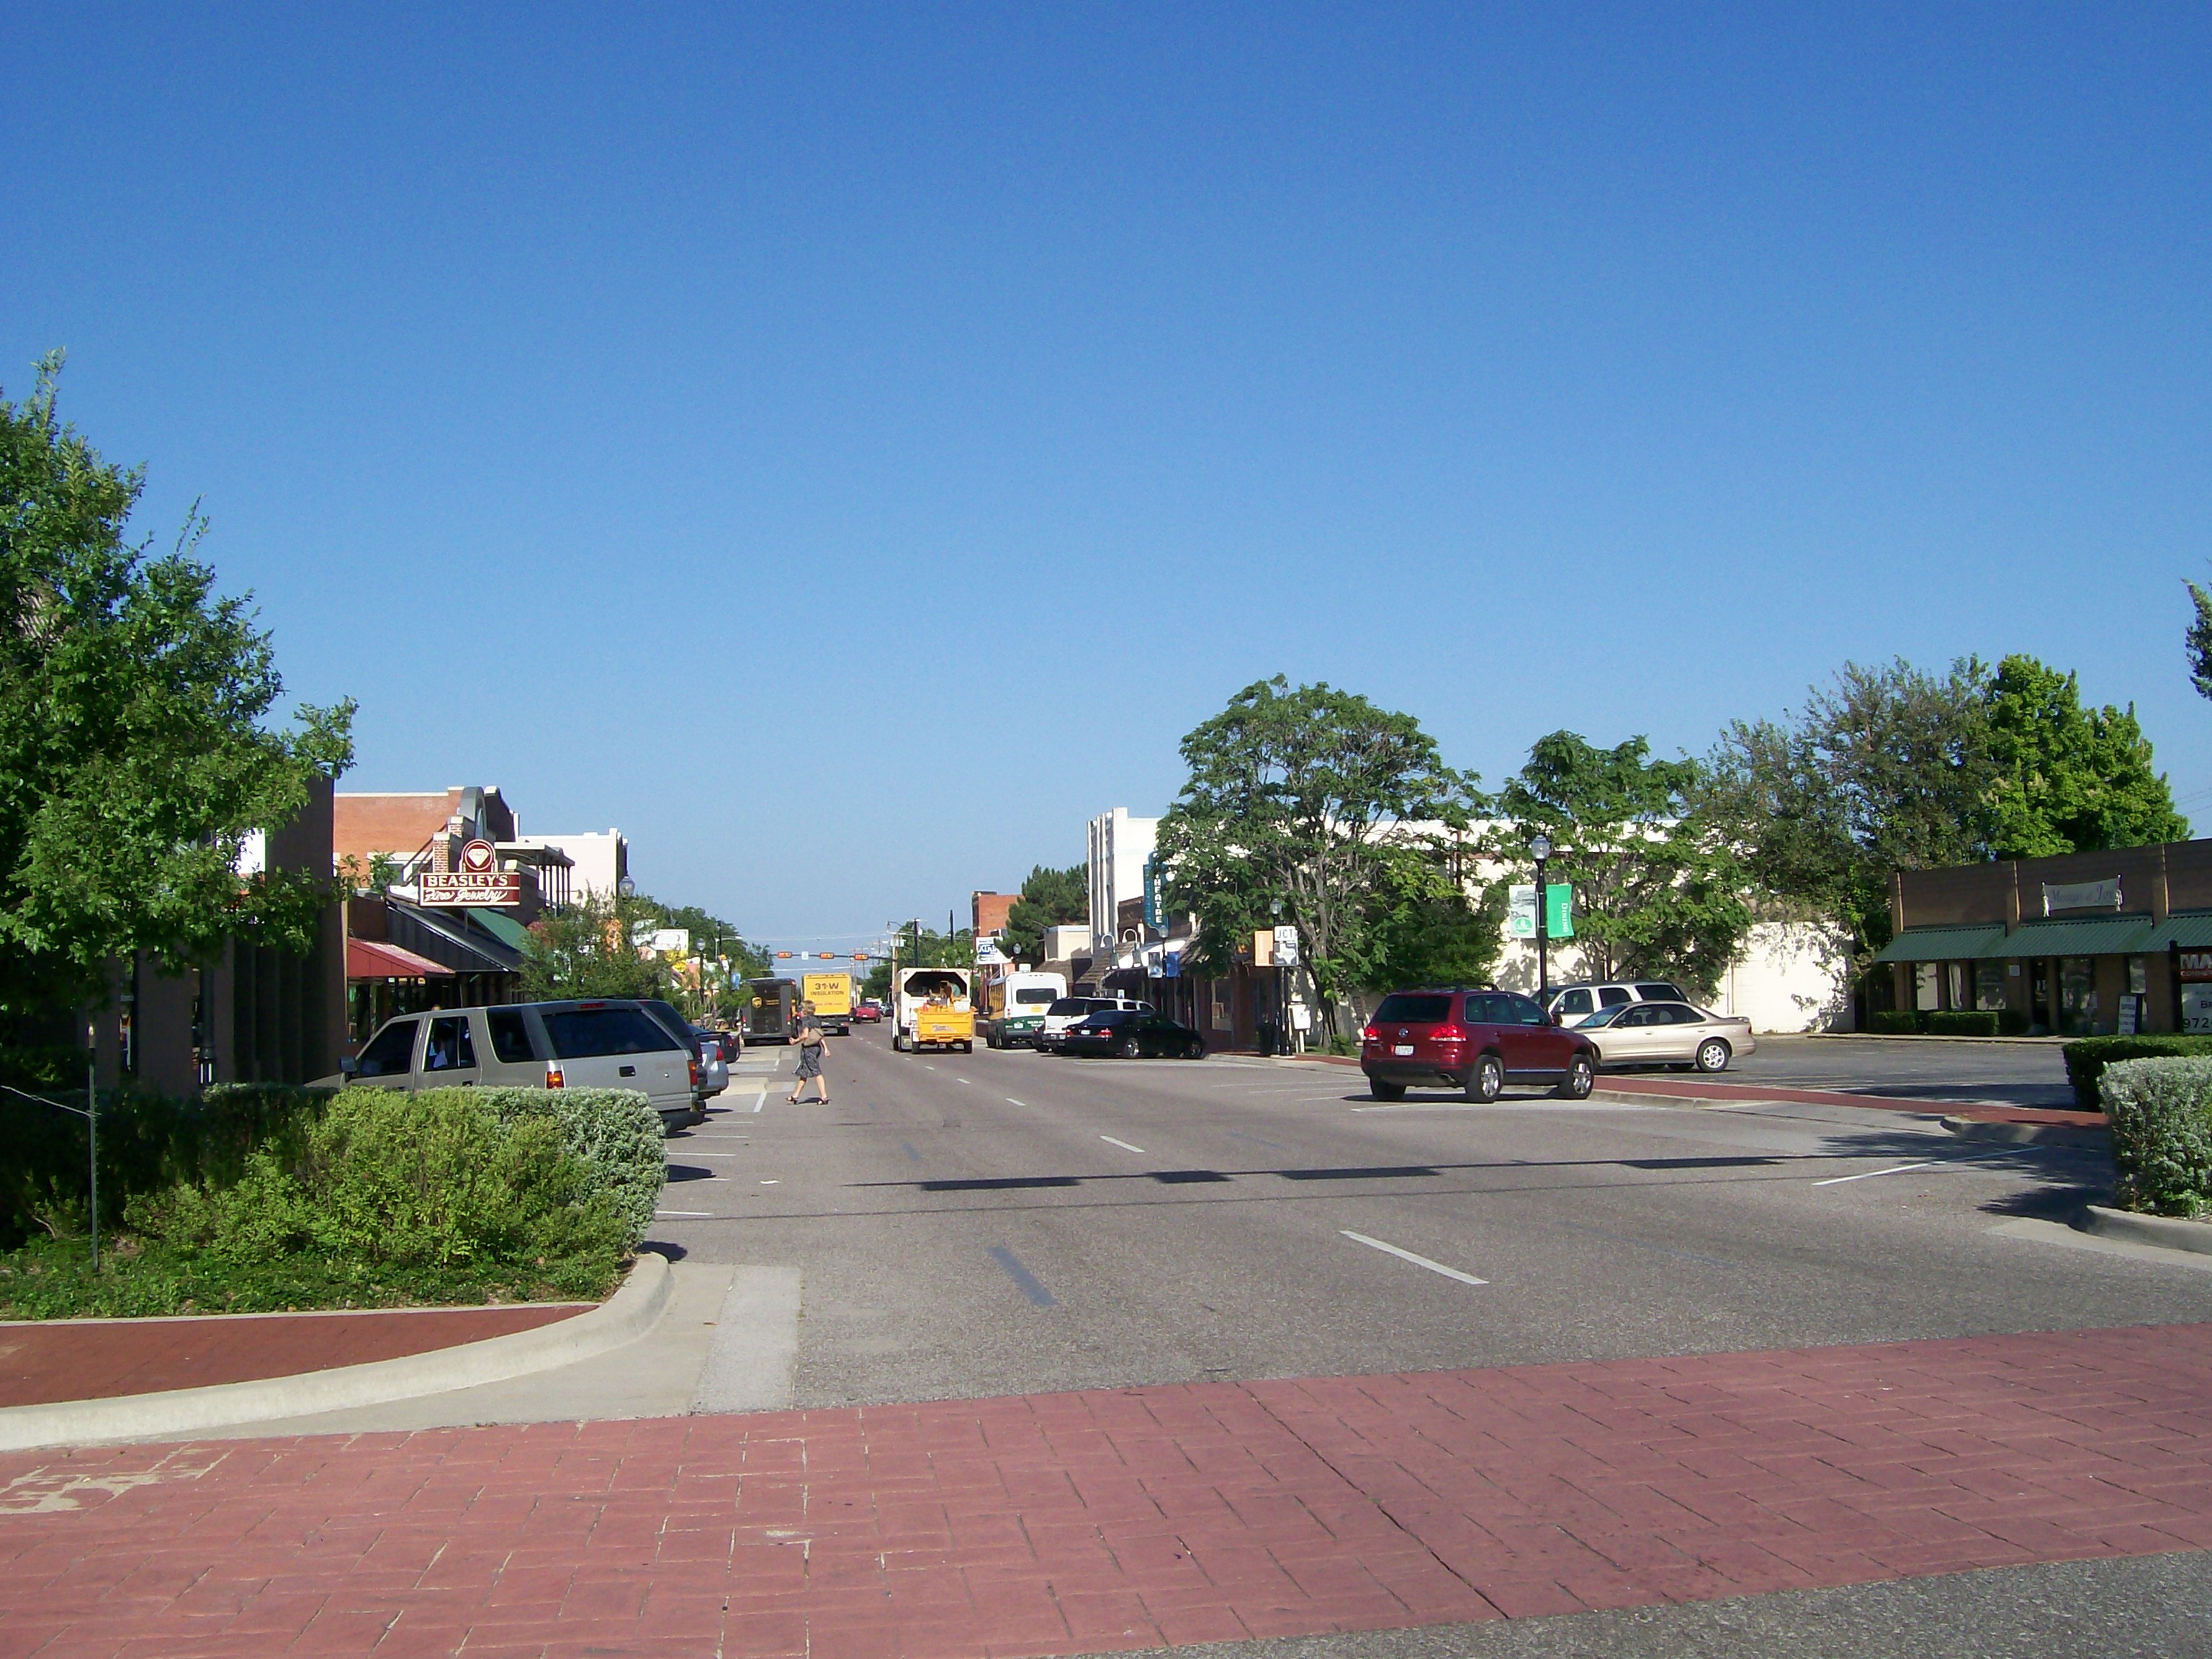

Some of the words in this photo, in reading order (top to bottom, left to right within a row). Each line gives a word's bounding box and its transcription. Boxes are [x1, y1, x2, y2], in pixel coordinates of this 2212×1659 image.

[427, 873, 508, 887] BEASLEY'S
[423, 889, 455, 902] Fine
[453, 889, 508, 903] Jewelry
[1277, 929, 1293, 939] JCT
